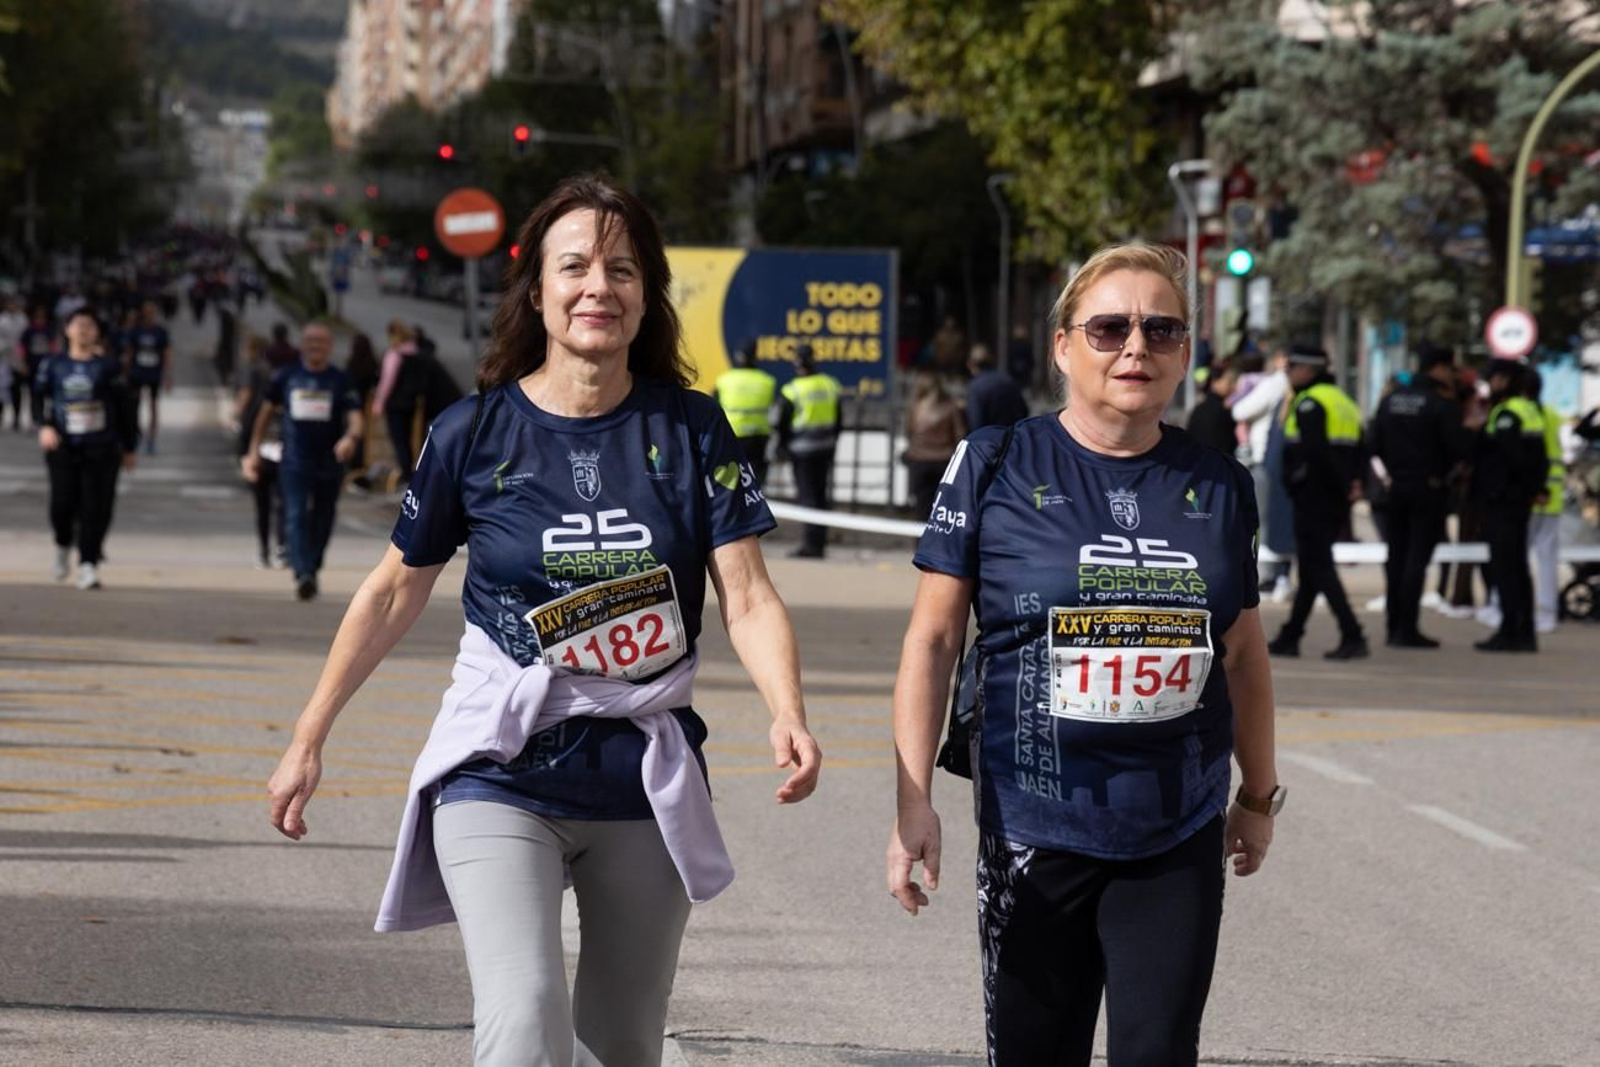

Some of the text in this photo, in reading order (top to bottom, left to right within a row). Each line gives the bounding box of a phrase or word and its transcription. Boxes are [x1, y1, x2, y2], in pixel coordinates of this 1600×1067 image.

[806, 282, 882, 308] TODO
[786, 309, 881, 335] LO QUE
[756, 335, 882, 362] ECSITAS
[542, 509, 652, 552] 25
[543, 550, 656, 566] CARRERA
[1079, 534, 1198, 569] 25
[1078, 565, 1203, 581] CARRERA
[563, 574, 665, 613] CARRERA POPULAR
[1079, 578, 1207, 595] POPULAR
[1079, 592, 1207, 605] y gran caminata
[576, 600, 604, 618] gran
[609, 582, 667, 603] caminata
[1014, 593, 1042, 615] IES
[535, 607, 564, 635] XXV
[1057, 615, 1092, 634] XXV
[1093, 614, 1201, 626] CARRERA POPULAR
[1093, 624, 1201, 635] y gran caminata
[562, 613, 670, 677] 1182
[1071, 654, 1191, 697] 1154
[1021, 708, 1034, 766] SANTA
[1039, 746, 1053, 772] DE
